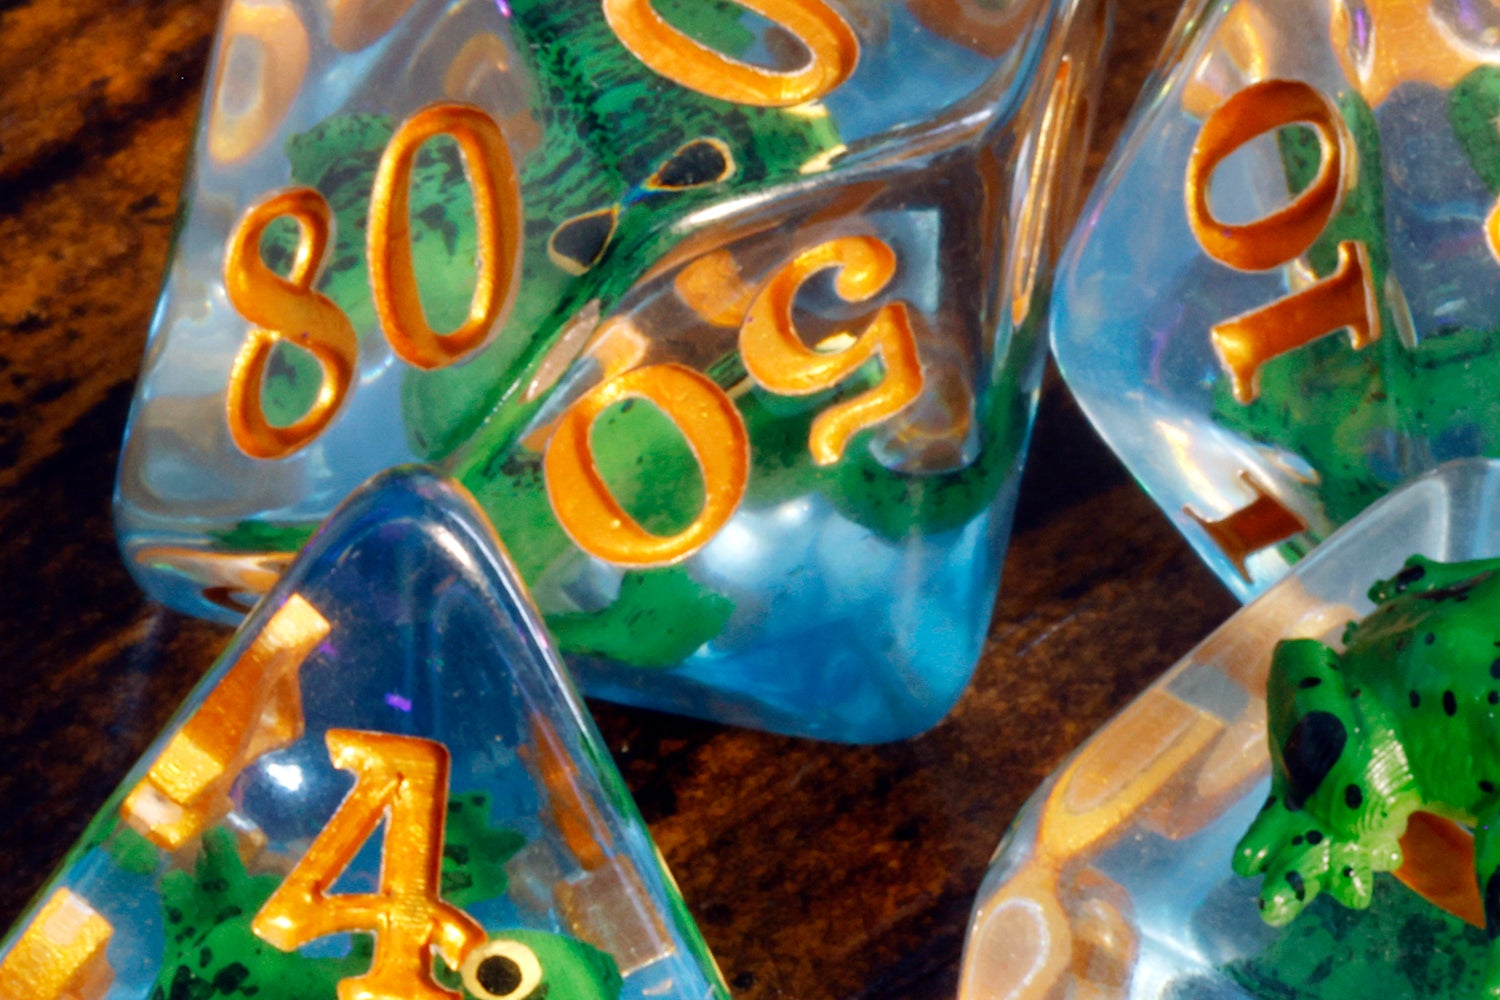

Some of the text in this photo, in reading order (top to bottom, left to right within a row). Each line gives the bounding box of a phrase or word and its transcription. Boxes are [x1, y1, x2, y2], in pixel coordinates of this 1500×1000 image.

[223, 101, 523, 460] 80
[543, 233, 924, 570] 50
[1185, 78, 1382, 404] 10
